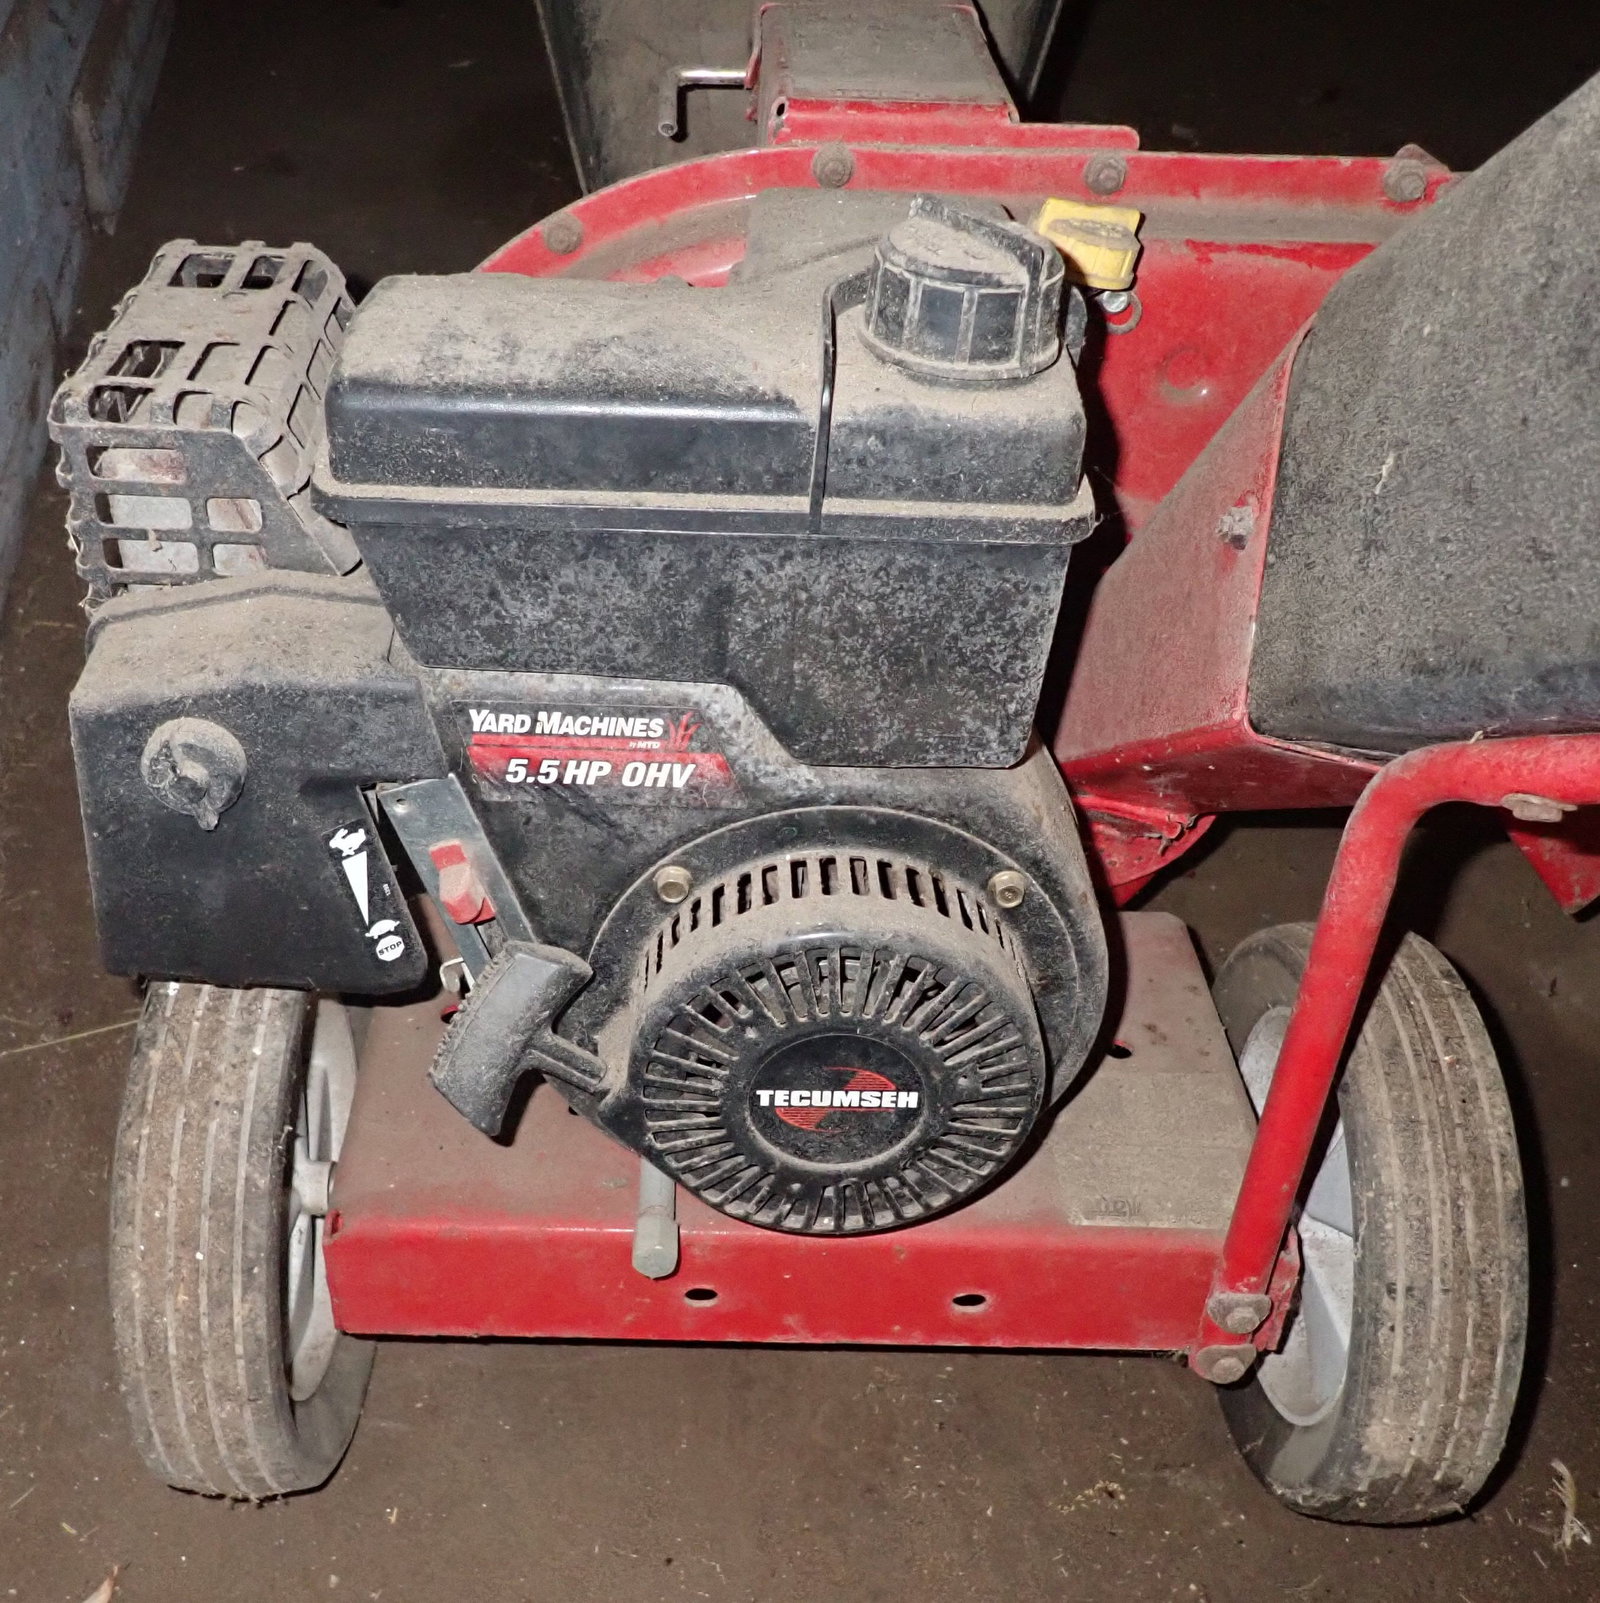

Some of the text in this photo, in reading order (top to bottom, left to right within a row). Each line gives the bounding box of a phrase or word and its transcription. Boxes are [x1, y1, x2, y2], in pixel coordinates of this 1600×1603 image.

[468, 709, 664, 738] YARD MACHINES
[505, 758, 696, 788] 5.5 HP OHV
[378, 940, 402, 956] STOP
[756, 1090, 919, 1108] TECUMSEH
